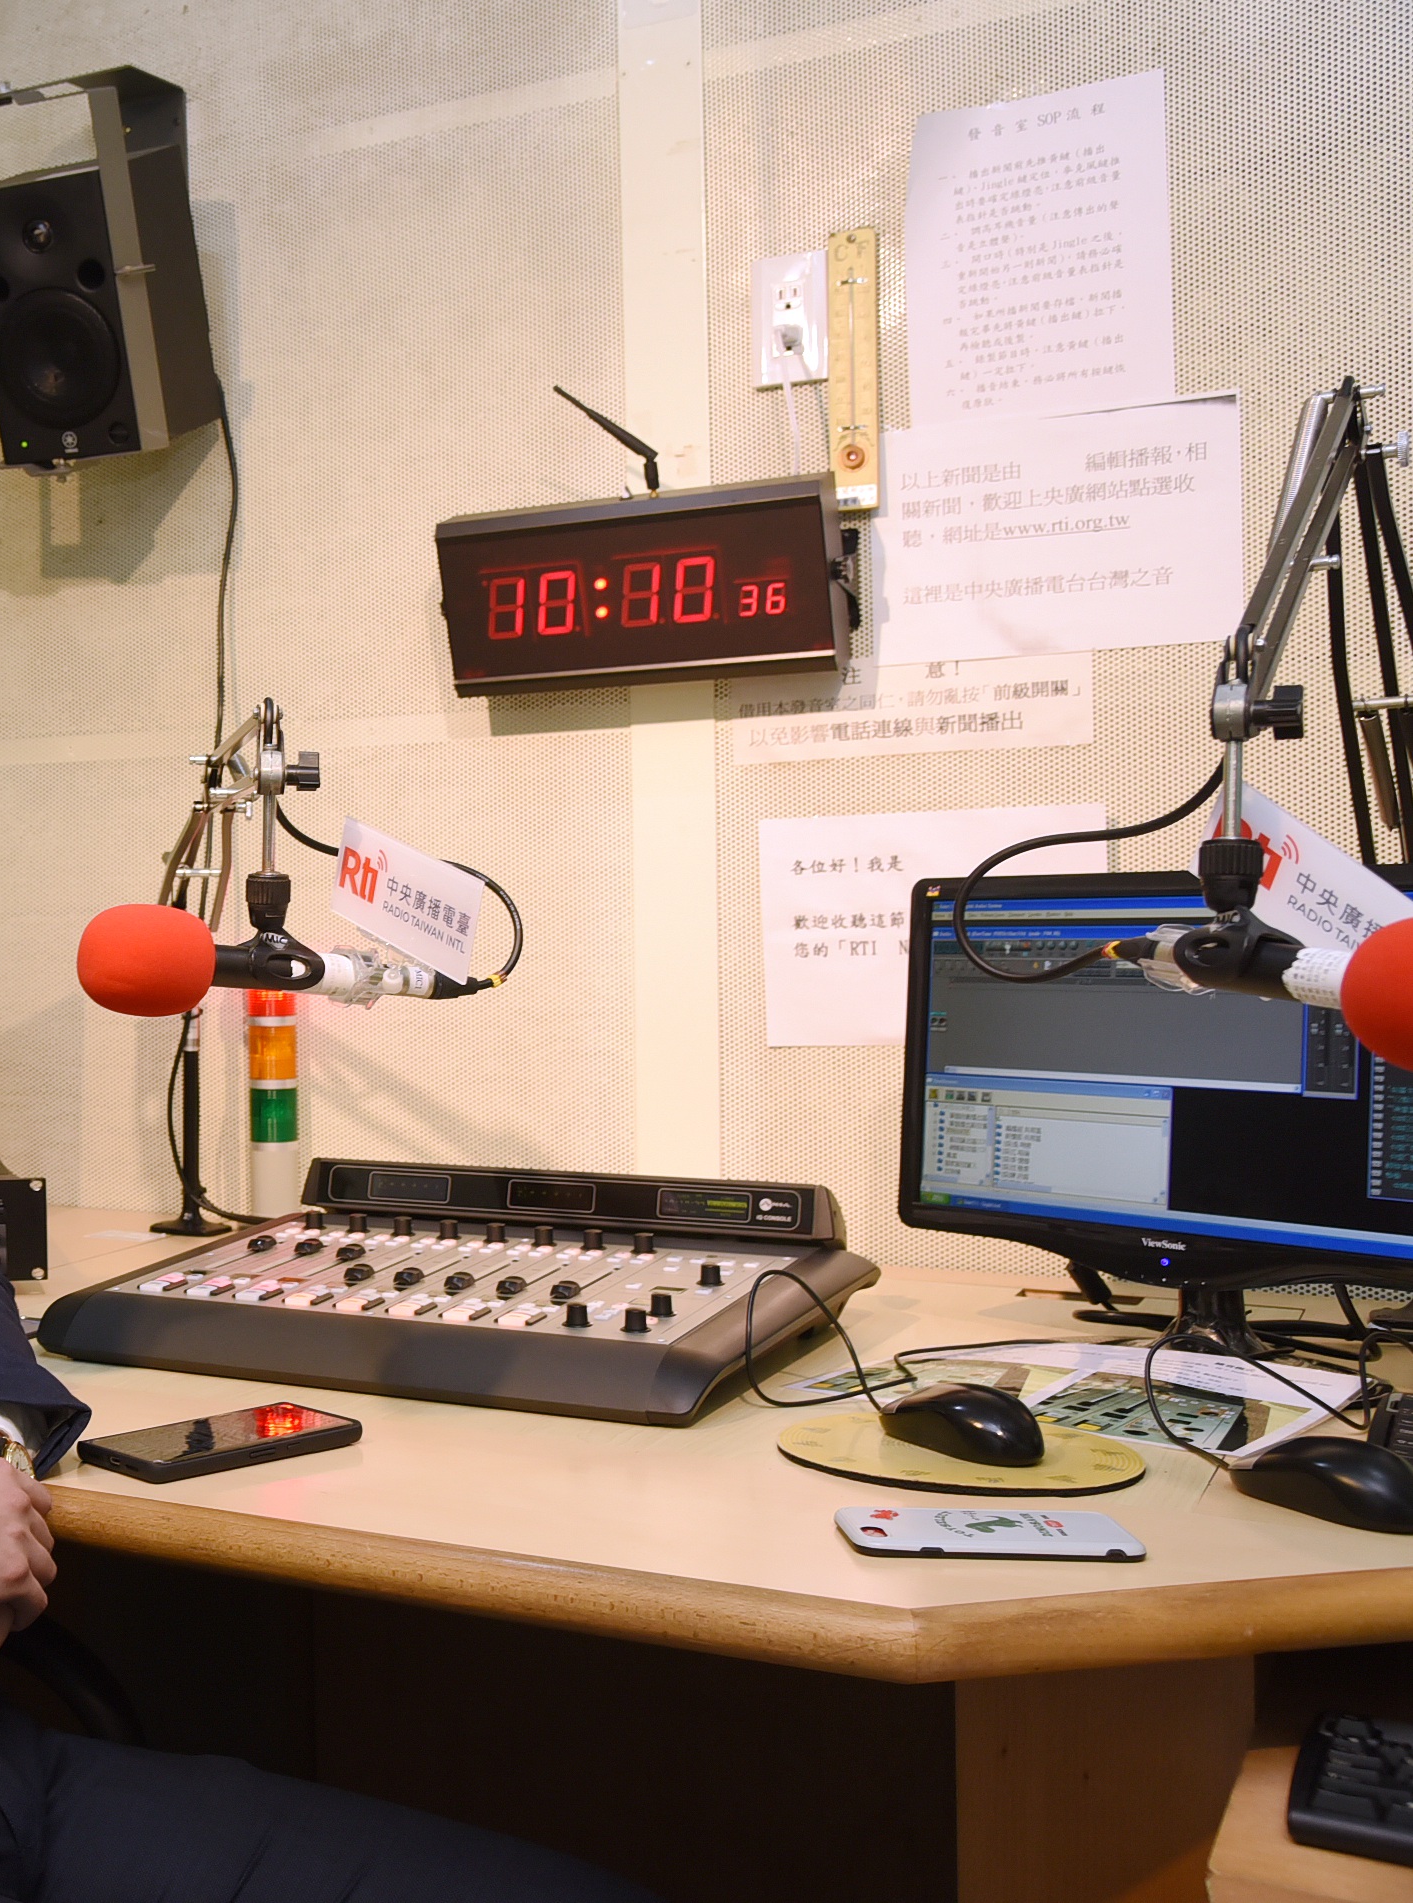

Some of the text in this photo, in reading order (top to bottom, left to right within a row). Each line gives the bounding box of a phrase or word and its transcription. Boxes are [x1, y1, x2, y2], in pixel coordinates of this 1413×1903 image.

[1037, 111, 1061, 127] SOP
[901, 442, 1208, 491] 以上新聞是由 編輯播報，相
[512, 556, 787, 637] 10:10 36
[903, 566, 1174, 605] 這裡是中央廣播電台台灣之音
[842, 667, 862, 686] 注
[749, 711, 1023, 748] 以免影響電話連線與新聞播出
[790, 855, 905, 875] 各位好！我是
[386, 876, 472, 936] 中央廣播電臺
[1287, 895, 1360, 950] RADIO TAI
[382, 901, 466, 954] RADIO TAIWAN INTL
[1141, 1237, 1186, 1252] ViewSonic
